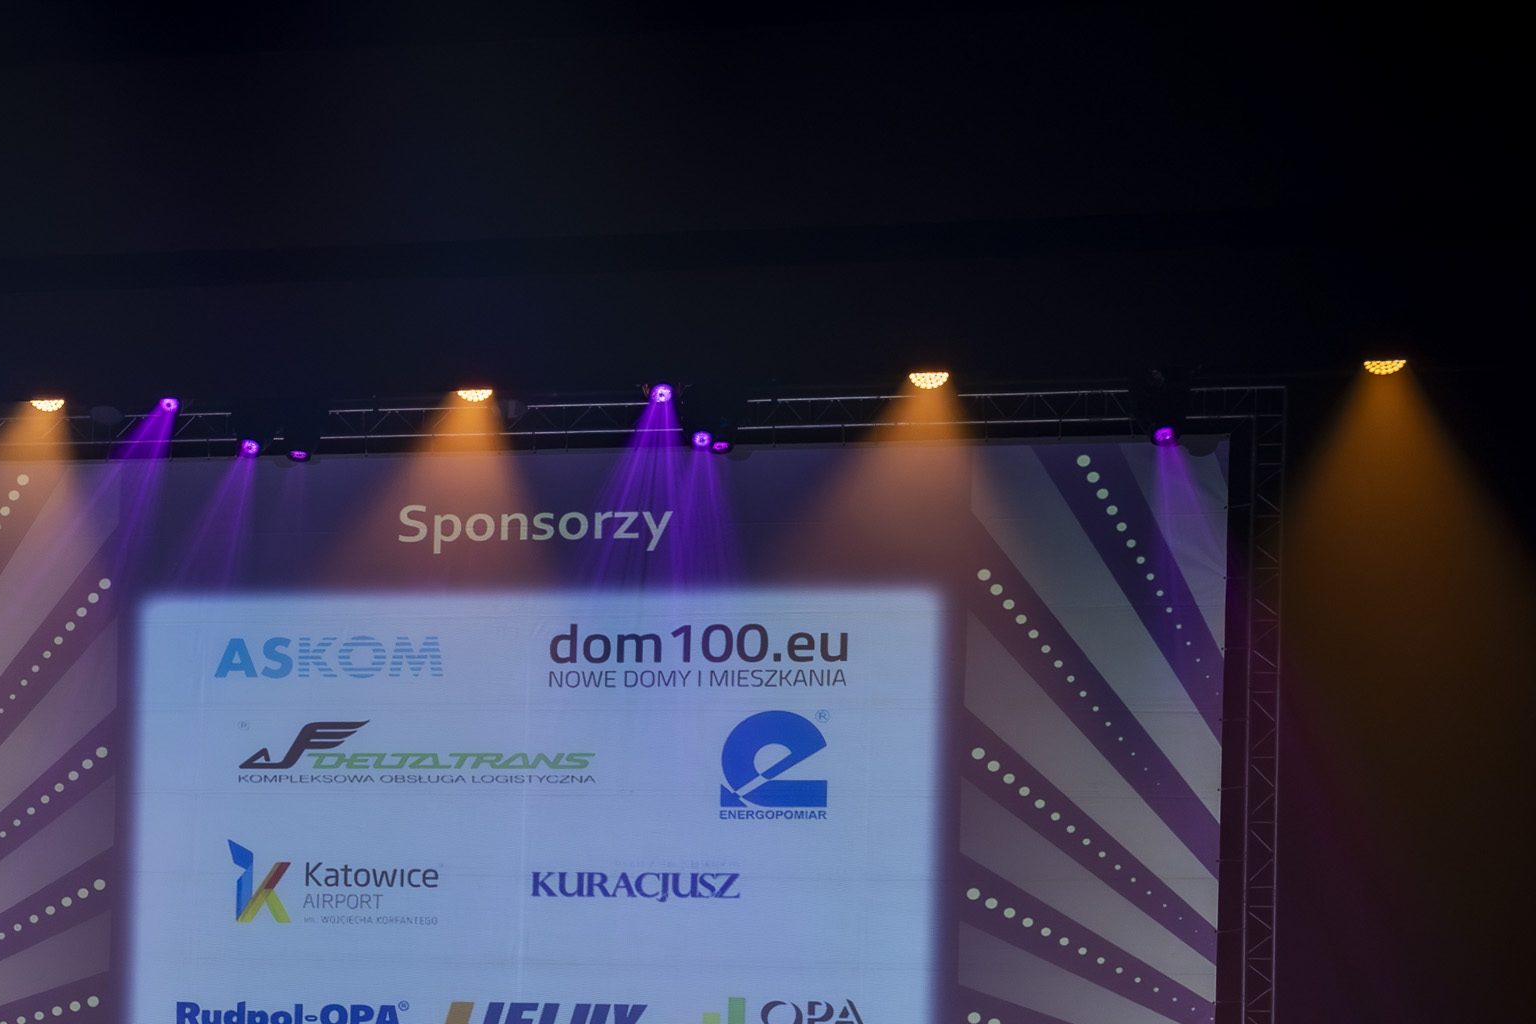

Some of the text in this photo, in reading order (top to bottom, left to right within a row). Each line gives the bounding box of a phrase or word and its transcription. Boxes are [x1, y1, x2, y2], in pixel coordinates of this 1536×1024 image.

[397, 503, 674, 554] Sponsorzy
[549, 622, 849, 664] dom100.eu
[214, 635, 444, 679] ASKOM
[548, 669, 847, 688] NOWE DOMY I MIESZKANIA
[238, 774, 596, 785] KOMPLEKSOWA OBSŁUGA LOGISTYCZNA
[719, 810, 827, 820] ENERGOPOMIAR
[305, 862, 439, 888] Katowice
[531, 871, 741, 903] KURACJUSZ
[303, 893, 383, 909] AIRPORT
